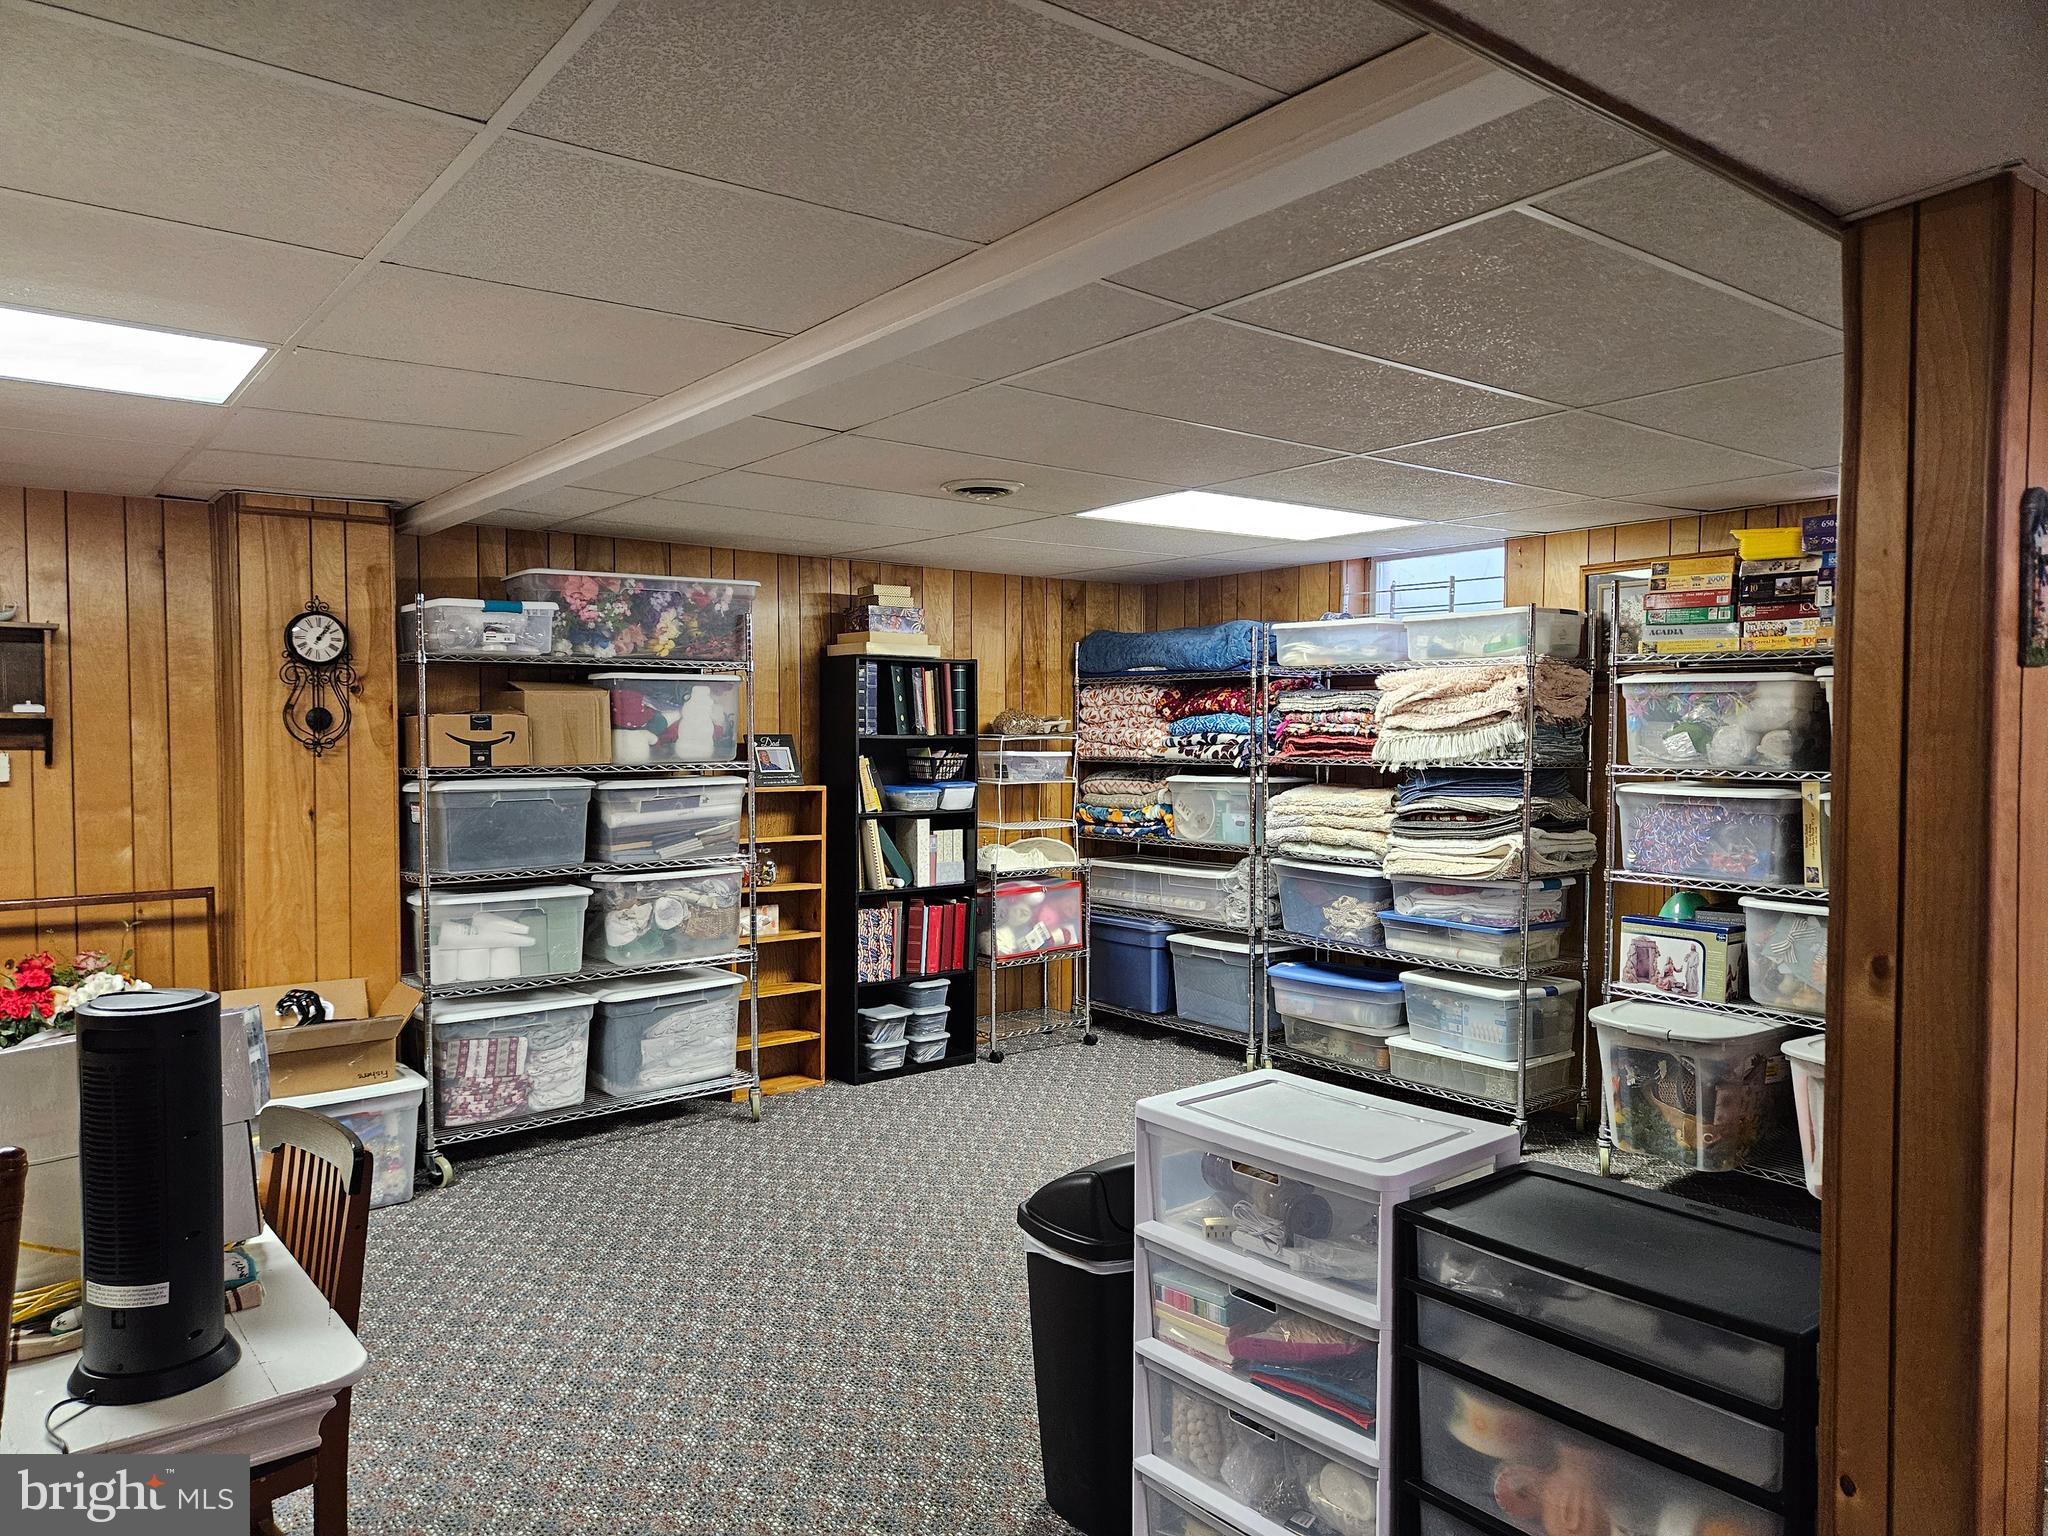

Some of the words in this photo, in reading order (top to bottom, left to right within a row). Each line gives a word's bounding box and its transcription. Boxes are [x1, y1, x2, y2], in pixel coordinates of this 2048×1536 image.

[1821, 519, 1835, 528] 650
[1821, 536, 1835, 545] 750
[1649, 628, 1684, 636] ACADIA
